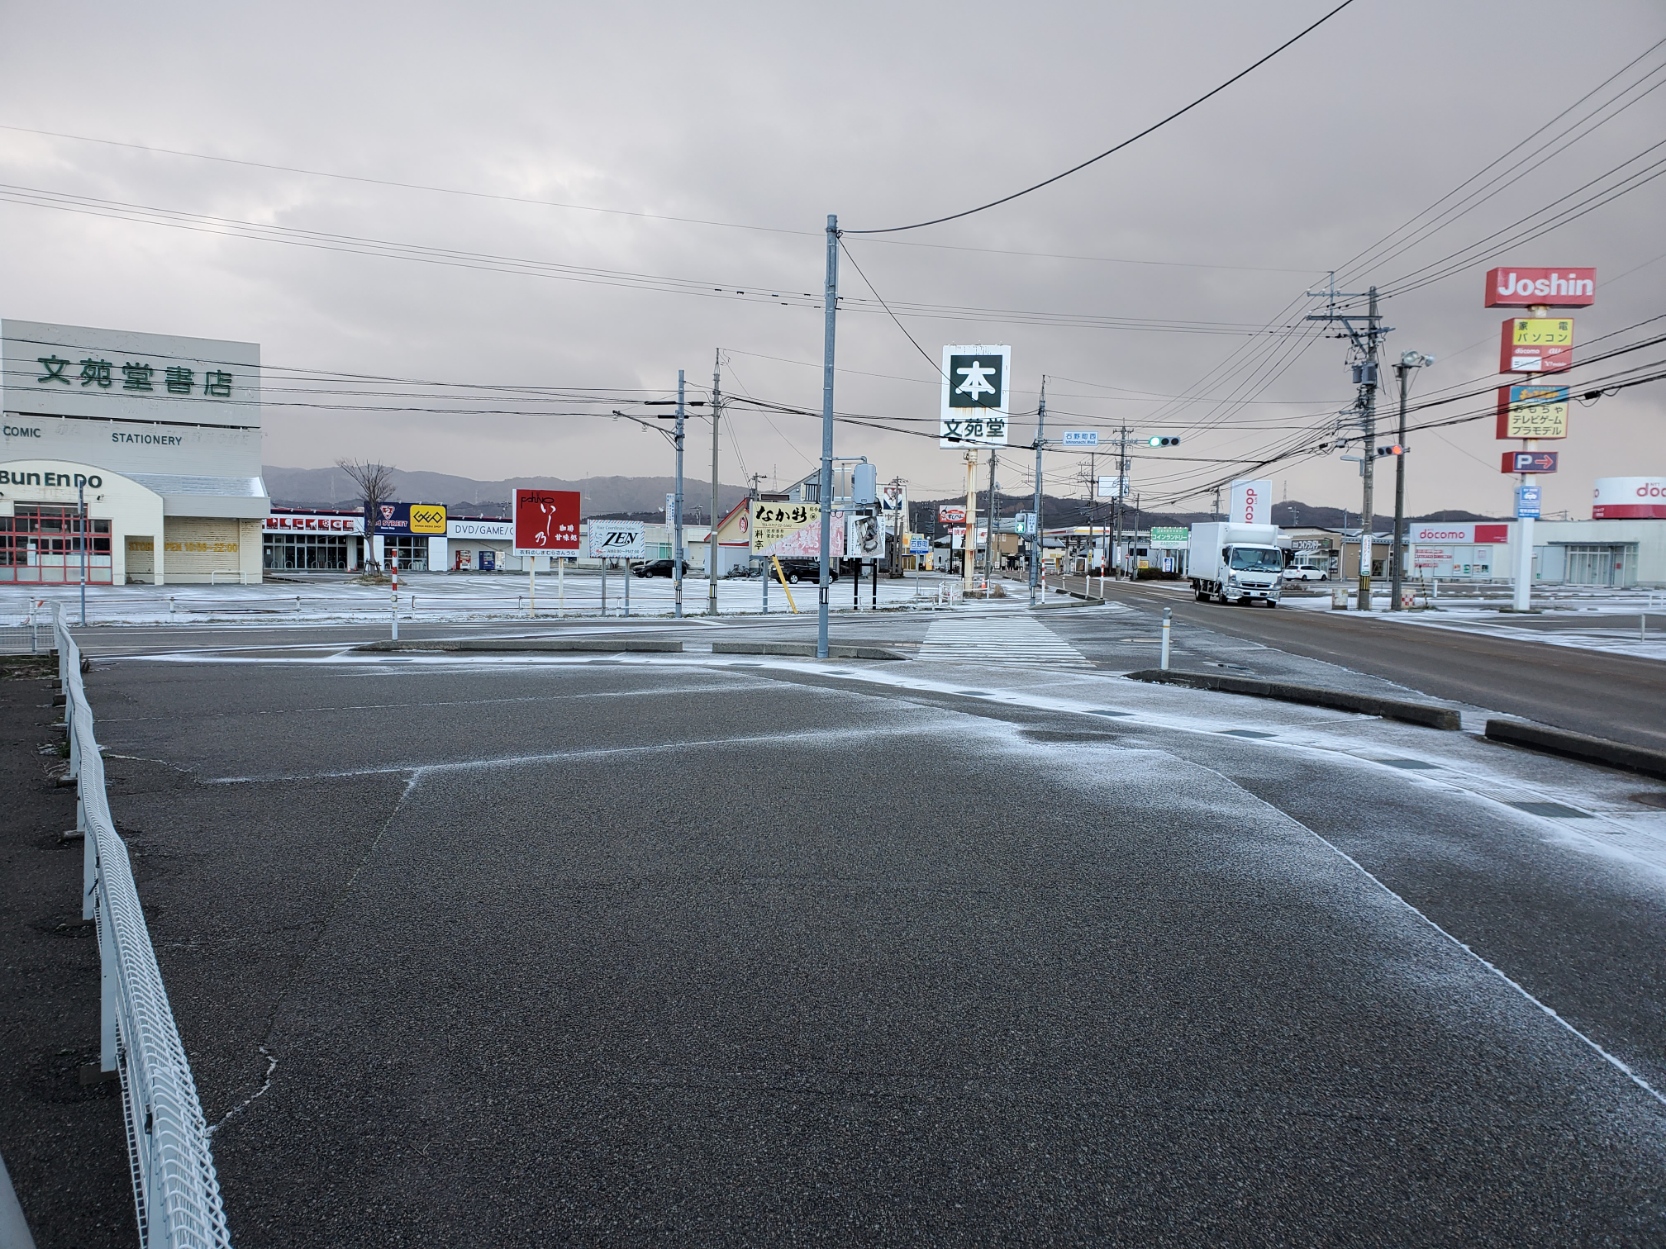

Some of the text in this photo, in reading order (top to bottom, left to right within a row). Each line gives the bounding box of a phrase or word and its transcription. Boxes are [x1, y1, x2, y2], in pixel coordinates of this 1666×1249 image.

[1498, 272, 1593, 296] Joshin
[1517, 334, 1567, 343] パソコン
[37, 354, 232, 397] 文苑堂書店
[955, 360, 996, 401] 本
[1513, 404, 1563, 414] おもちゃ
[1512, 415, 1563, 424] テレビゲーム
[3, 425, 41, 438] COMIC
[944, 418, 1005, 437] 文苑堂
[1512, 426, 1562, 435] プラモデル
[111, 432, 183, 446] STATIONERY
[1517, 454, 1533, 469] P
[413, 510, 443, 524] GEO
[602, 531, 639, 548] ZEN
[755, 529, 764, 550] 料亭
[1419, 528, 1465, 539] docomo
